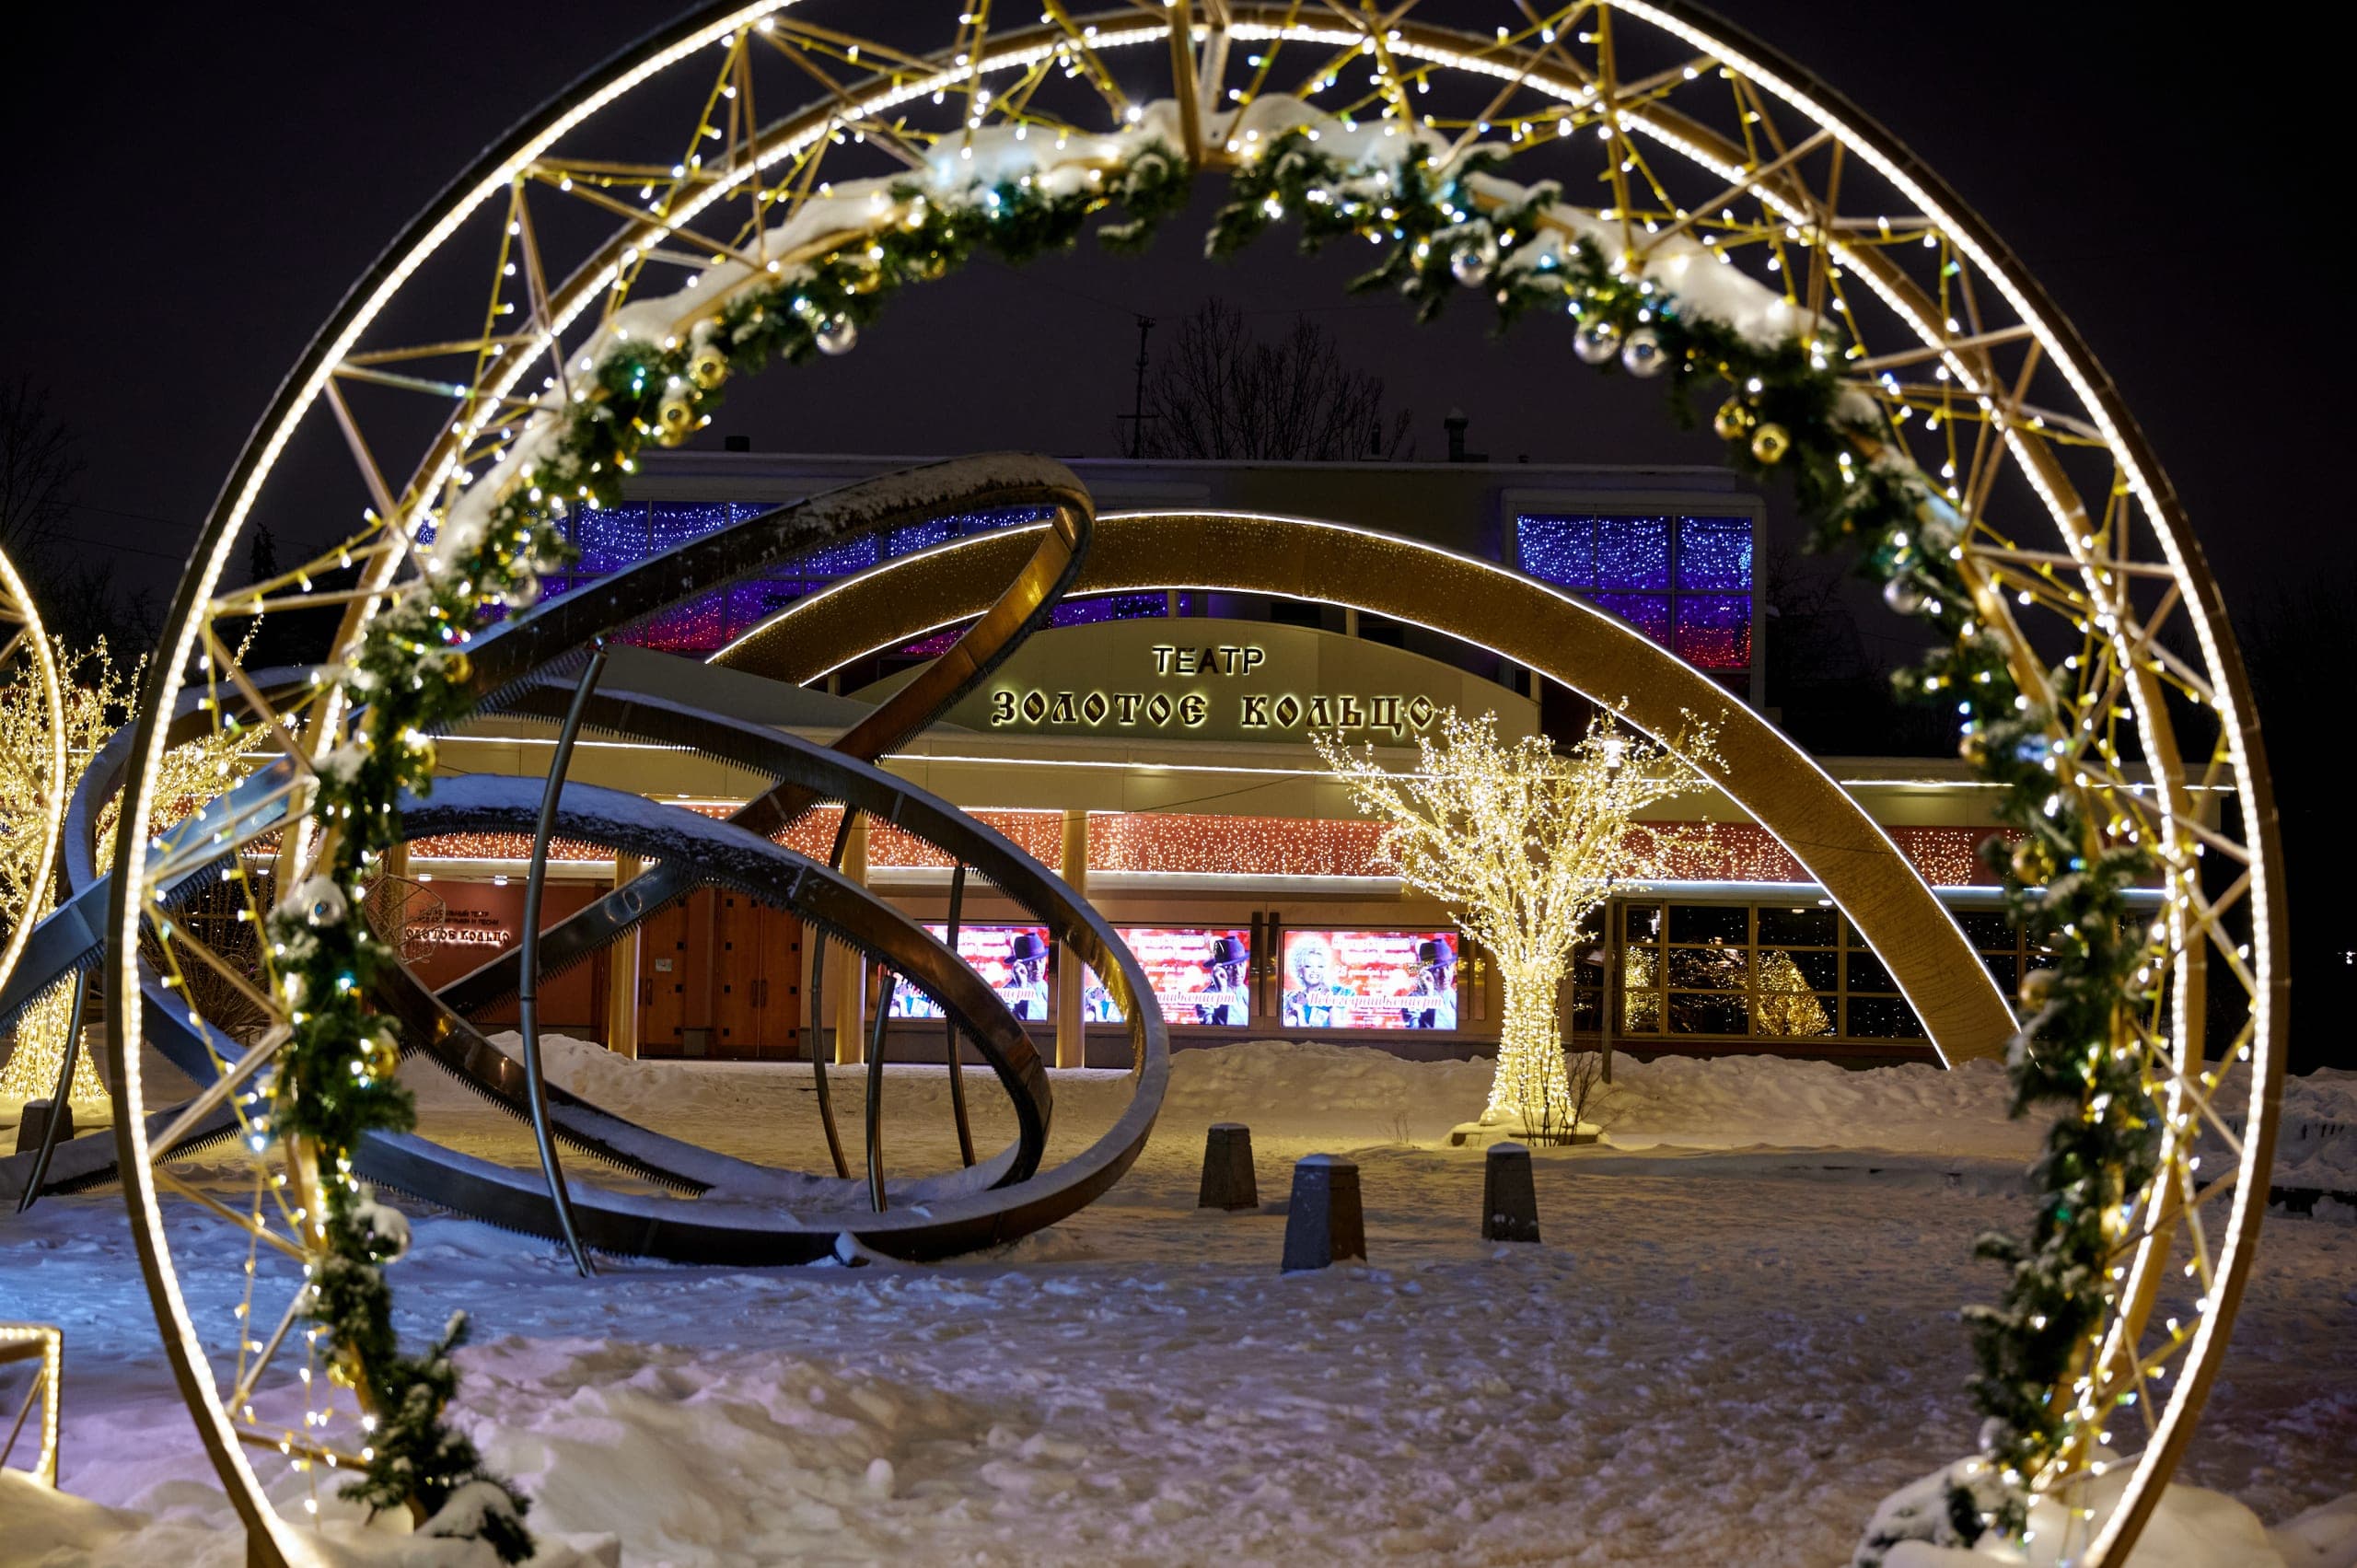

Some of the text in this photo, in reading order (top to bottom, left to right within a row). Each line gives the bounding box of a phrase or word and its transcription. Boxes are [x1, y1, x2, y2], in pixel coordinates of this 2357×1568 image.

[1153, 646, 1264, 674] ТЕАТР
[1241, 694, 1435, 736] КОЛЬЦО
[406, 928, 458, 941] ОЛОТОЕ
